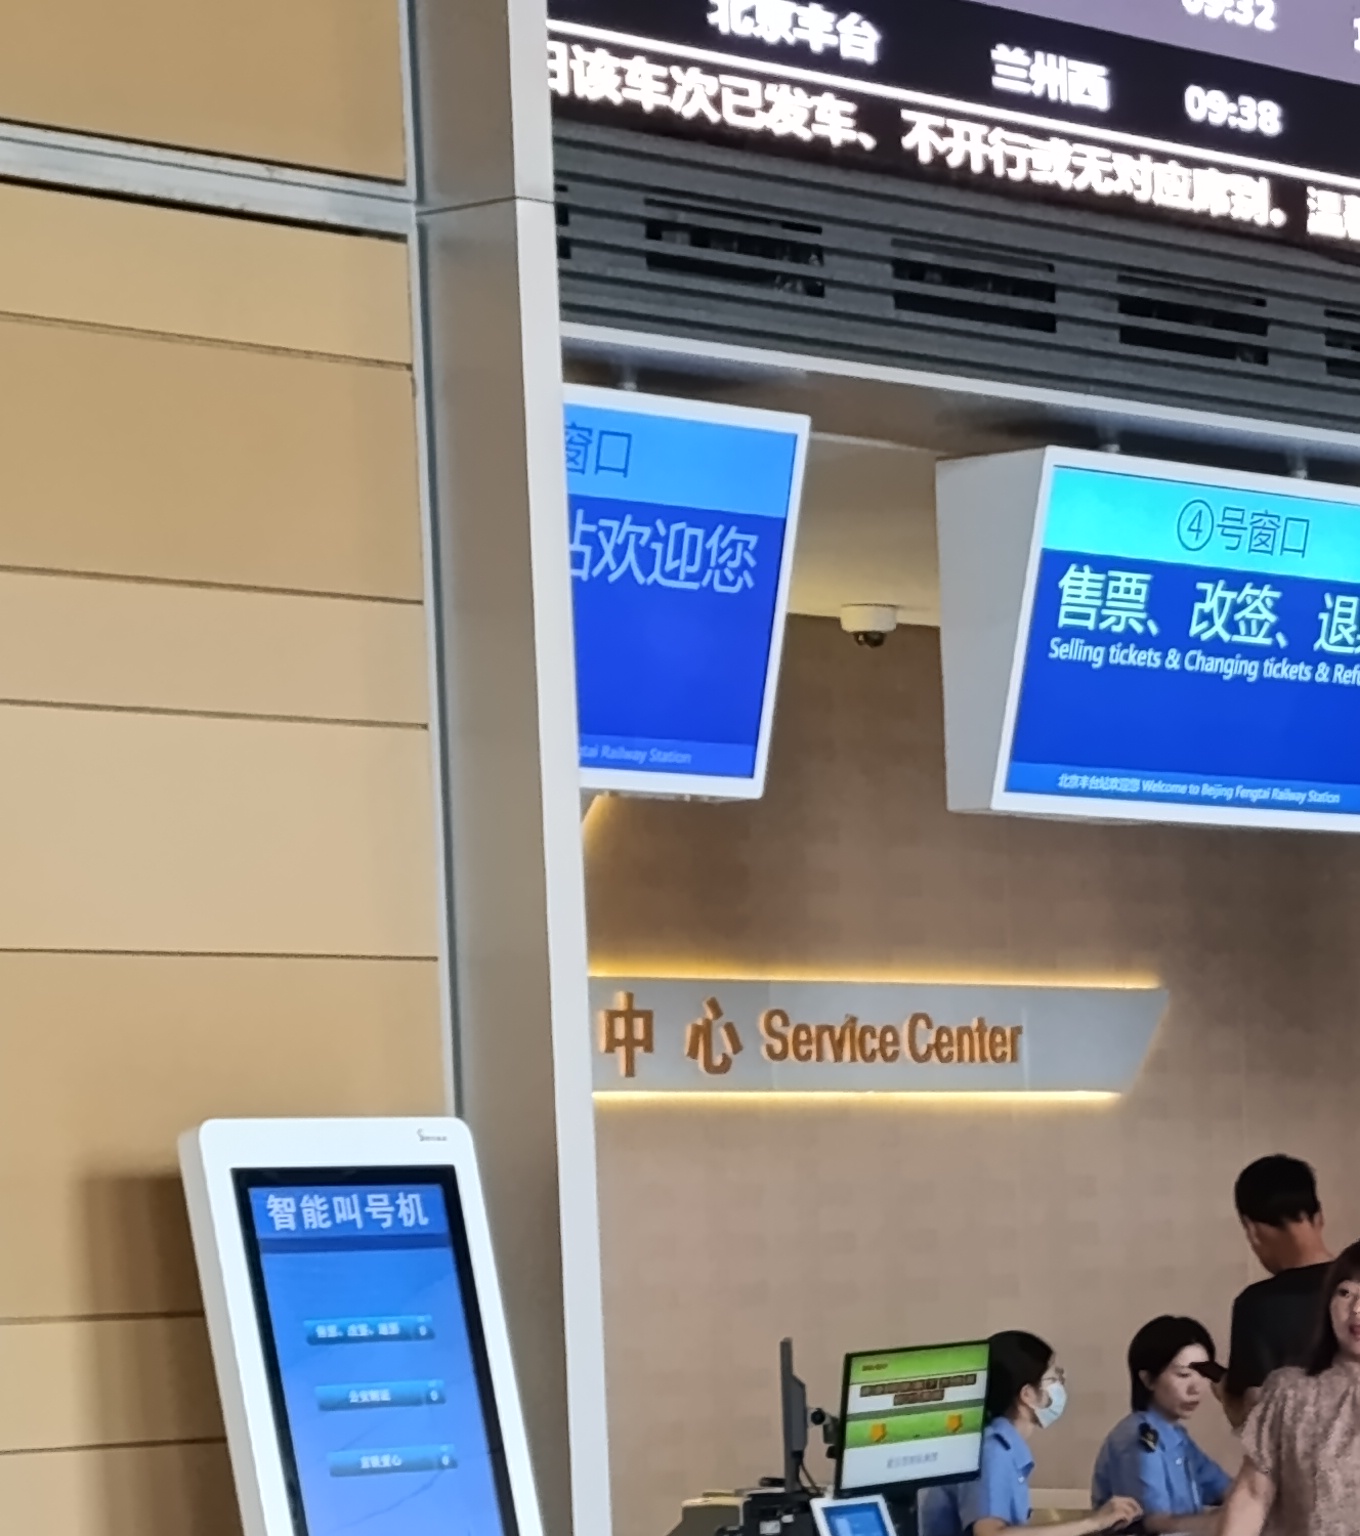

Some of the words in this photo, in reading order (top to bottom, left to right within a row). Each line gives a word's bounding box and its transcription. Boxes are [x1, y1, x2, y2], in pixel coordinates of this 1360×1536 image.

[990, 43, 1111, 111] 兰州西
[1184, 85, 1282, 134] 09:38
[1048, 636, 1105, 669] Selling
[1108, 642, 1161, 669] tickets
[1165, 648, 1181, 670] &
[1184, 649, 1259, 682] Changing
[1263, 657, 1312, 682] tickets
[1315, 662, 1330, 683] &
[1141, 779, 1187, 795] Welcome
[1188, 784, 1200, 796] to
[1201, 783, 1234, 800] Beijing
[1235, 785, 1271, 802] Fengtai
[1272, 788, 1306, 804] Railway
[1307, 789, 1340, 804] Station
[761, 1008, 901, 1065] Service
[905, 1010, 1024, 1065] Center
[266, 1192, 430, 1231] 智能叫号机
